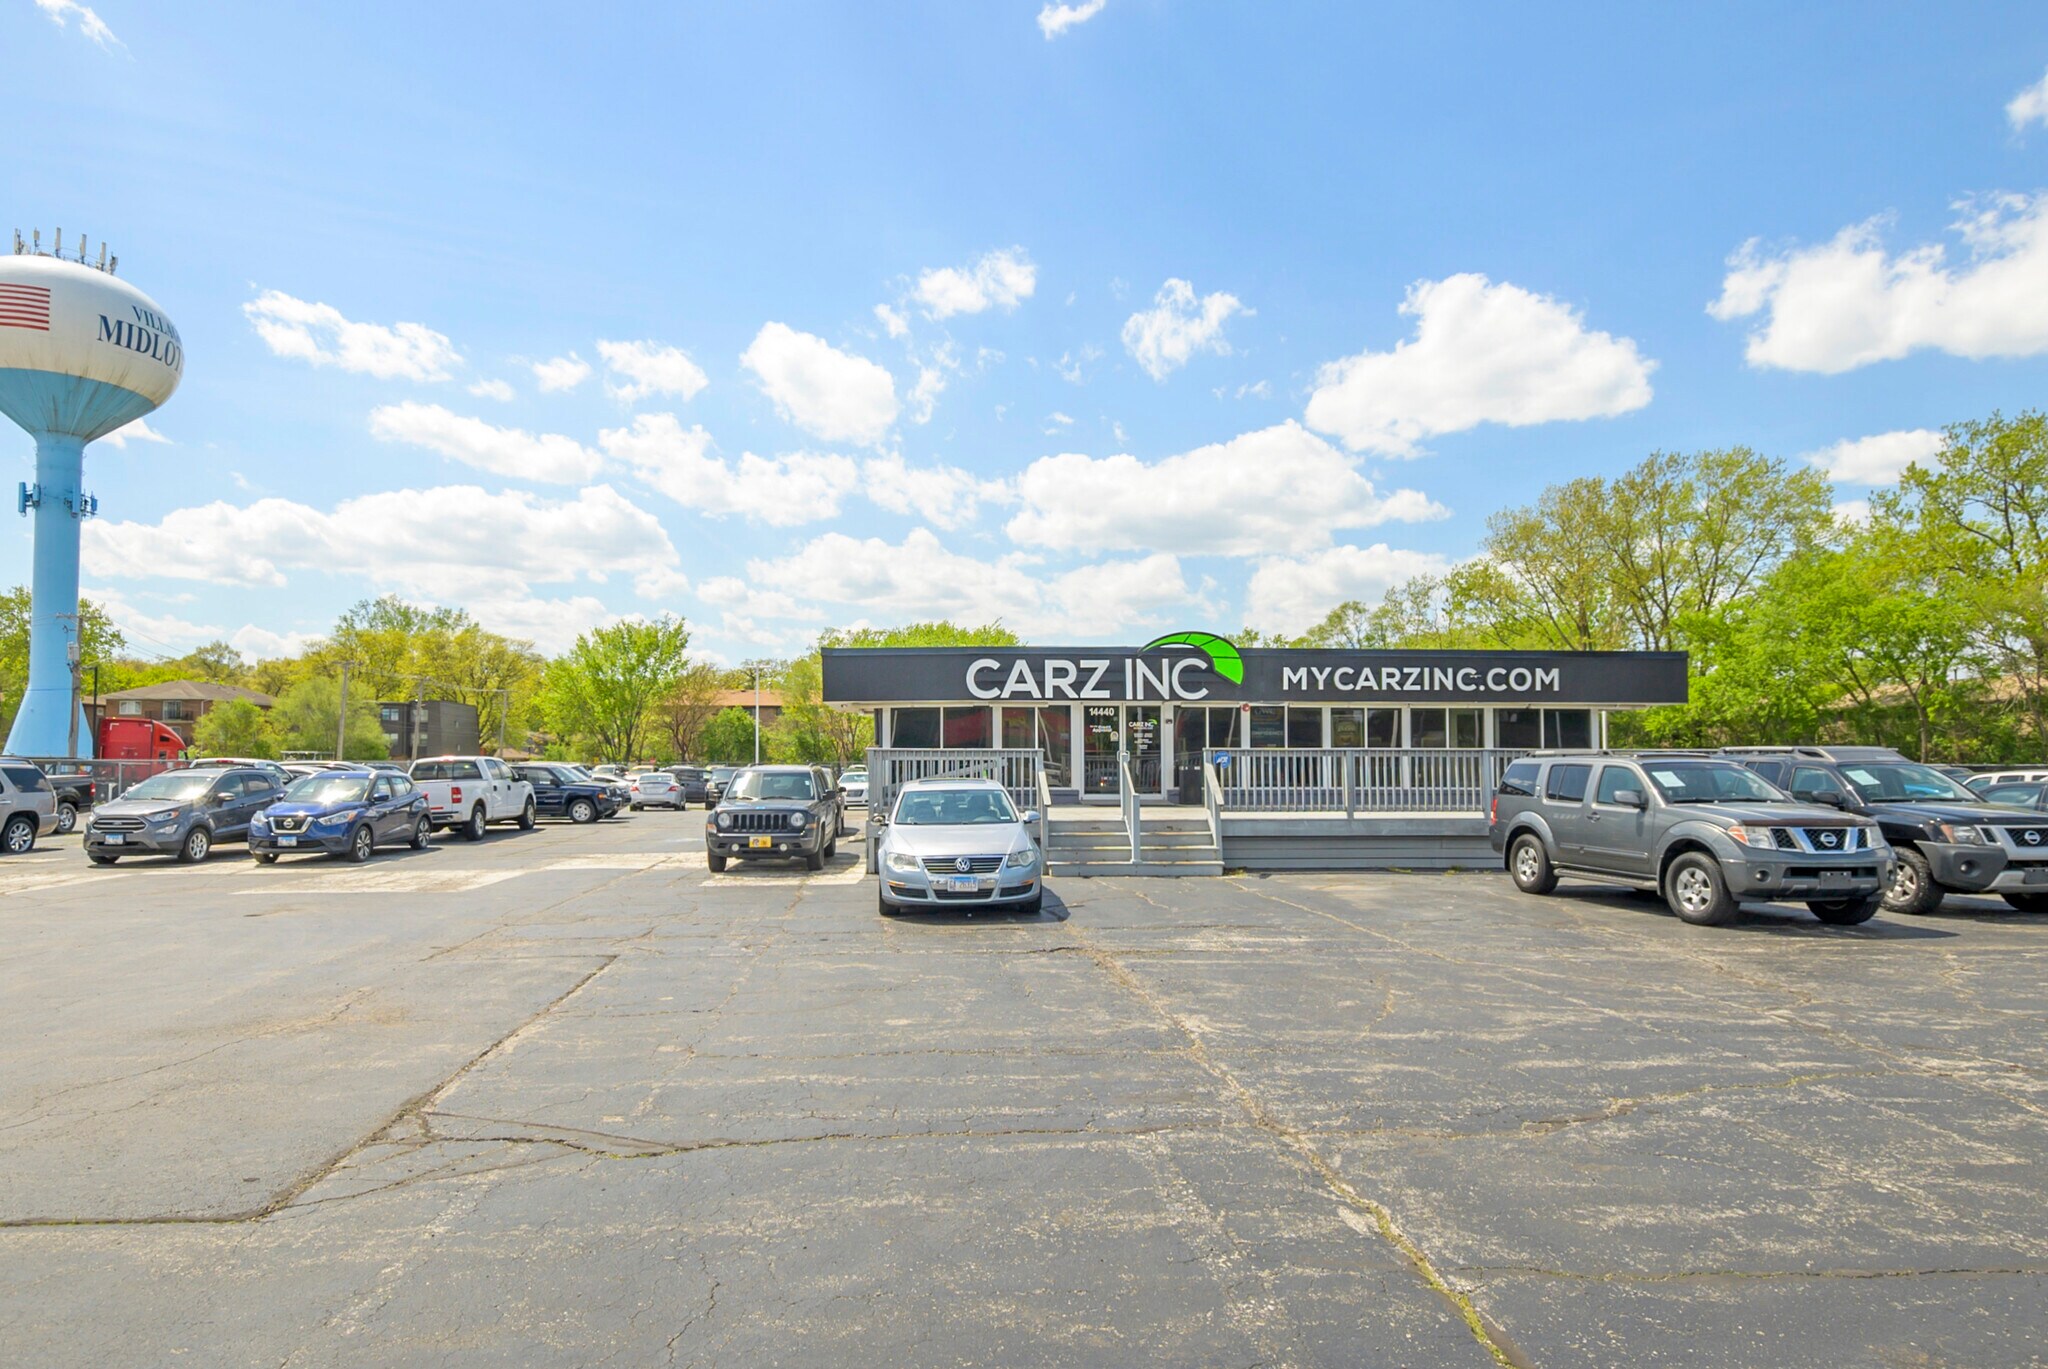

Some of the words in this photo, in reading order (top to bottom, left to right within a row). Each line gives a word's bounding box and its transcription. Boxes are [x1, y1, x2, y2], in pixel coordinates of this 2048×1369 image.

[966, 658, 1110, 699] CARZ
[1125, 658, 1209, 700] INC
[1283, 667, 1560, 691] MYCARZINC.COM
[1089, 707, 1115, 716] 14440
